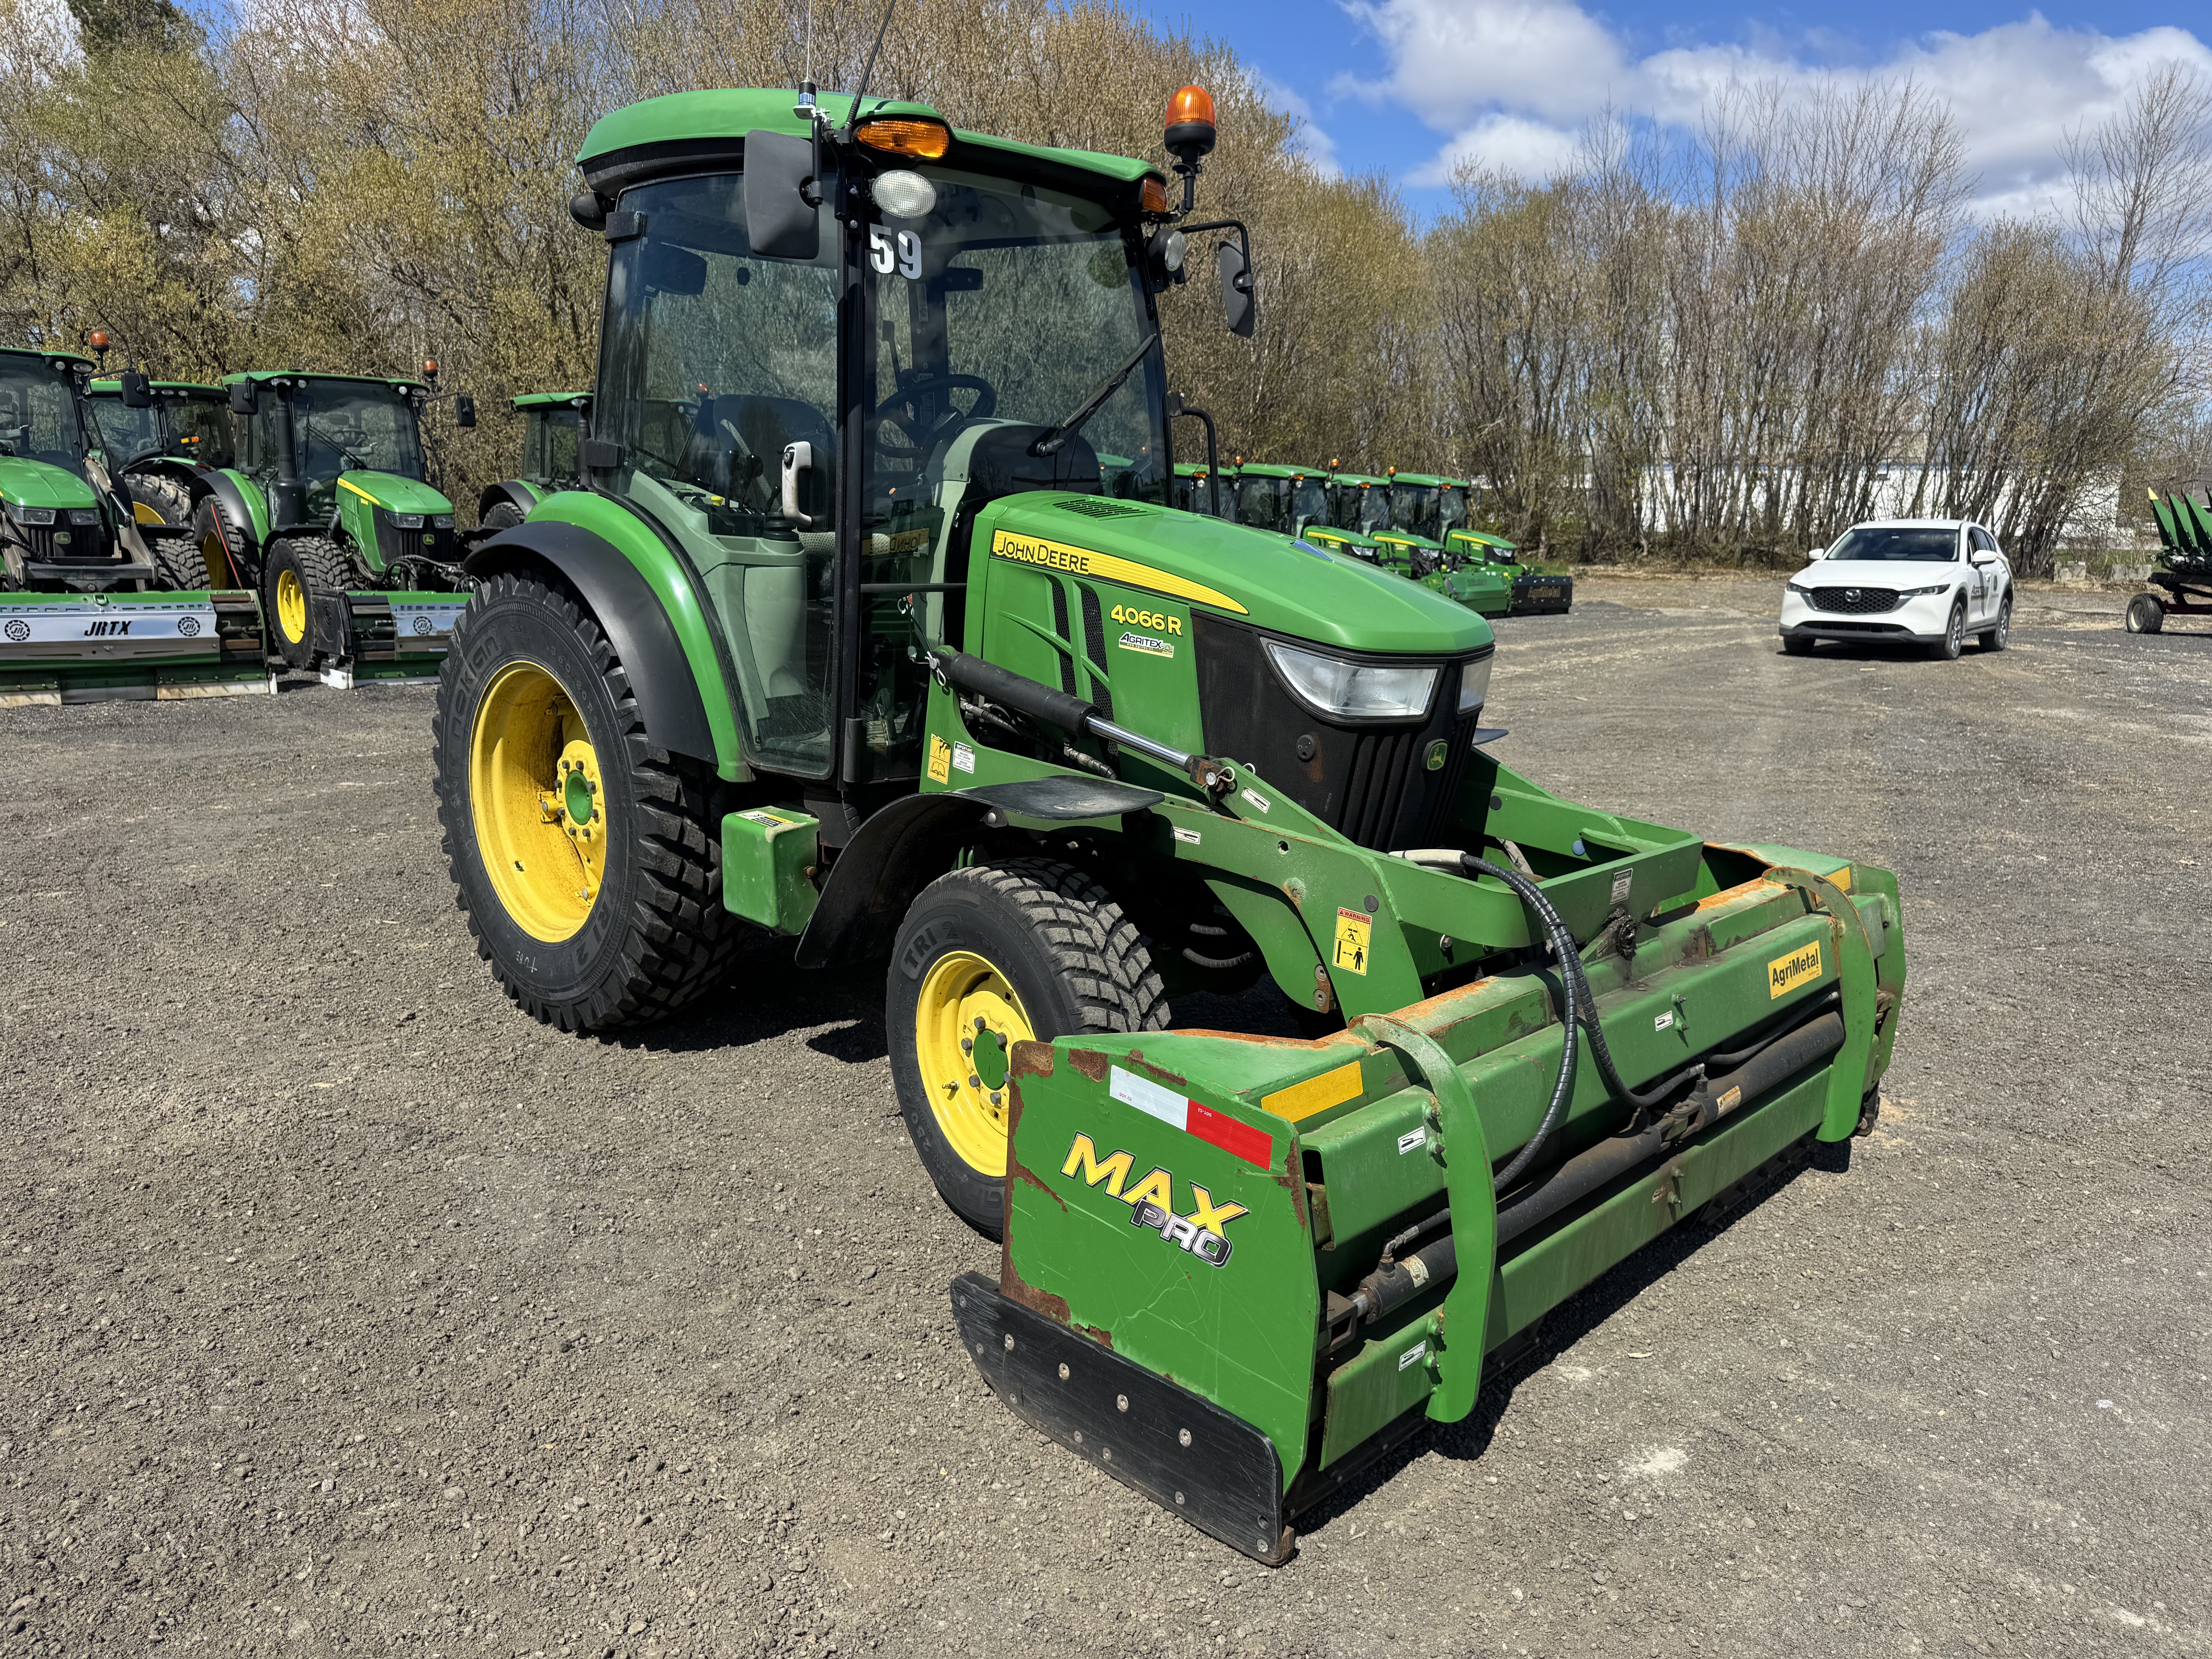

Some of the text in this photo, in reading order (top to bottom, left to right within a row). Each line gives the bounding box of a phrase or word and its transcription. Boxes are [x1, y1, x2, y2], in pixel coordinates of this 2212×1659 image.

[869, 223, 922, 280] 59
[998, 537, 1090, 572] JOHN DEERE
[84, 621, 132, 636] JRTX
[1121, 634, 1162, 648] AGRITEX
[1345, 911, 1369, 922] WARNING
[903, 921, 960, 969] TRI 2
[1772, 948, 1819, 987] AgriMetal
[1060, 1131, 1251, 1238] MAX
[1129, 1198, 1233, 1267] PRO
